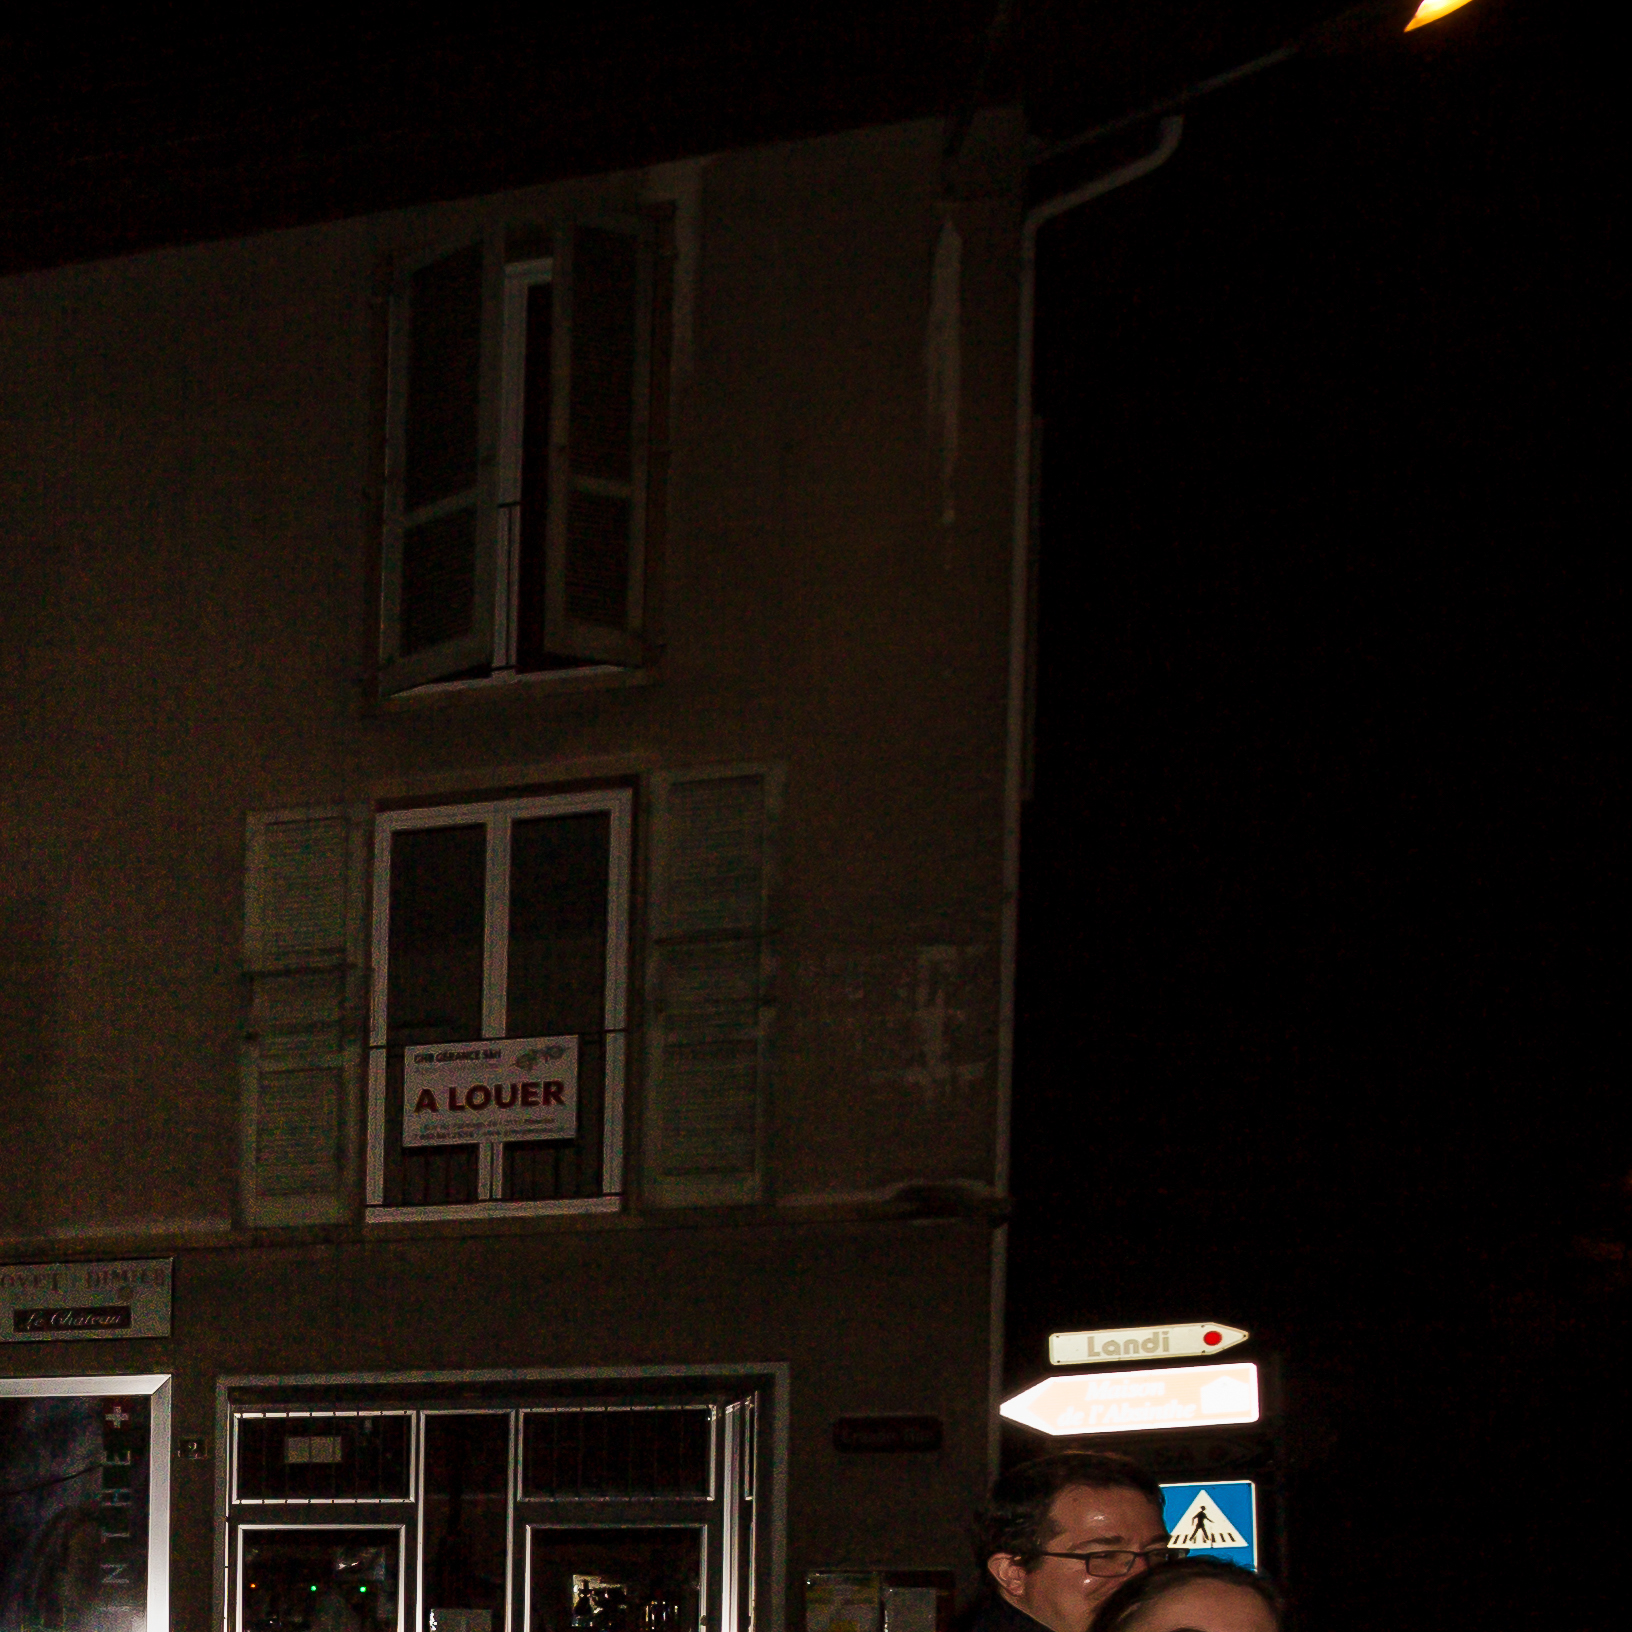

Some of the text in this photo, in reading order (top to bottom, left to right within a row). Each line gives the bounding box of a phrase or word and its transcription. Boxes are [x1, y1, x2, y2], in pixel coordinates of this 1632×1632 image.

[414, 1081, 565, 1112] A LOUER
[1087, 1330, 1170, 1357] Landi
[1085, 1378, 1166, 1401] Maison
[1056, 1405, 1085, 1427] de
